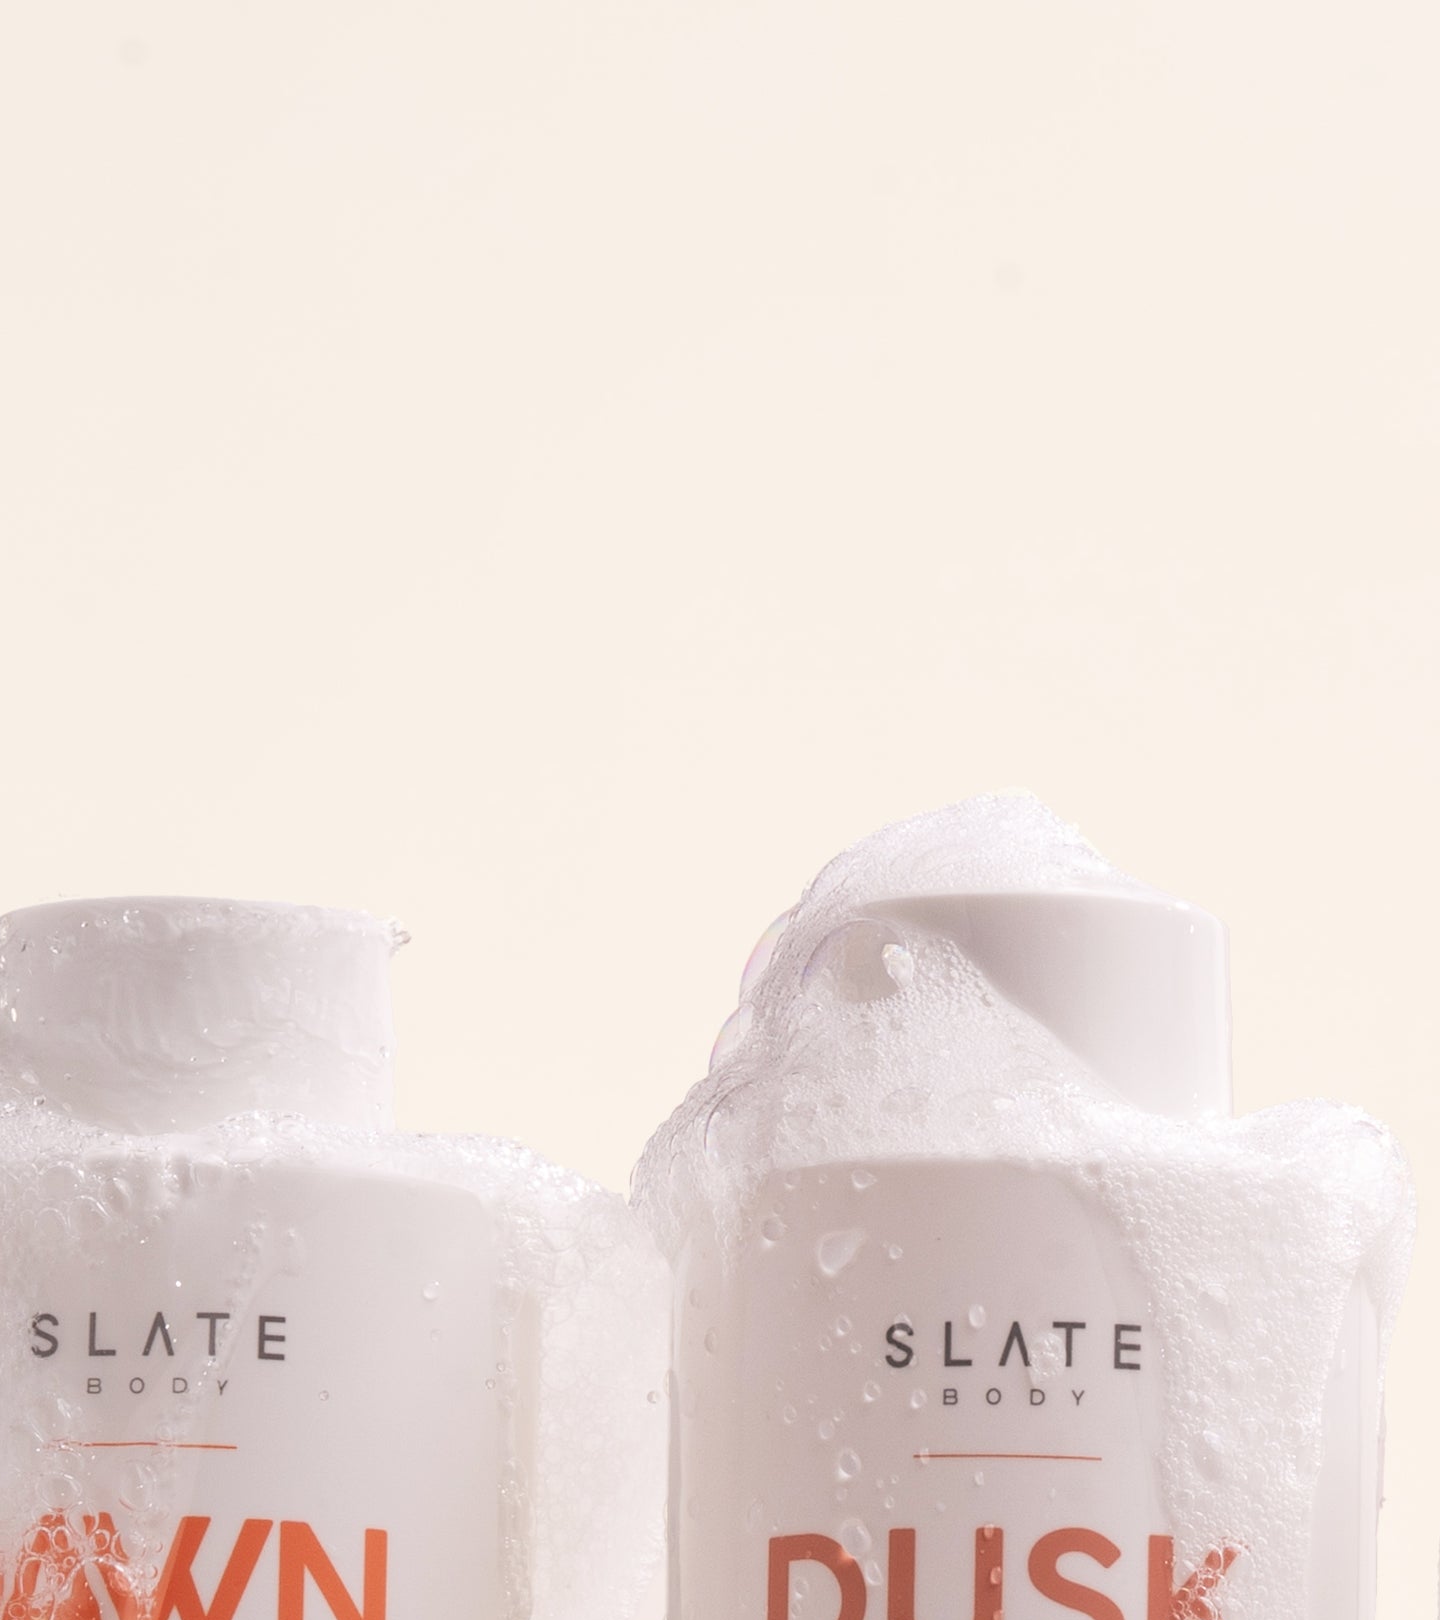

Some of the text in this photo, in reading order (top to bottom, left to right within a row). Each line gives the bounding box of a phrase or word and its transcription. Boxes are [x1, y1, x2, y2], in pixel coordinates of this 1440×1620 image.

[30, 1312, 286, 1361] SLATE
[885, 1321, 1141, 1370] SLATE
[87, 1377, 228, 1397] BODY
[942, 1388, 1085, 1406] BODY
